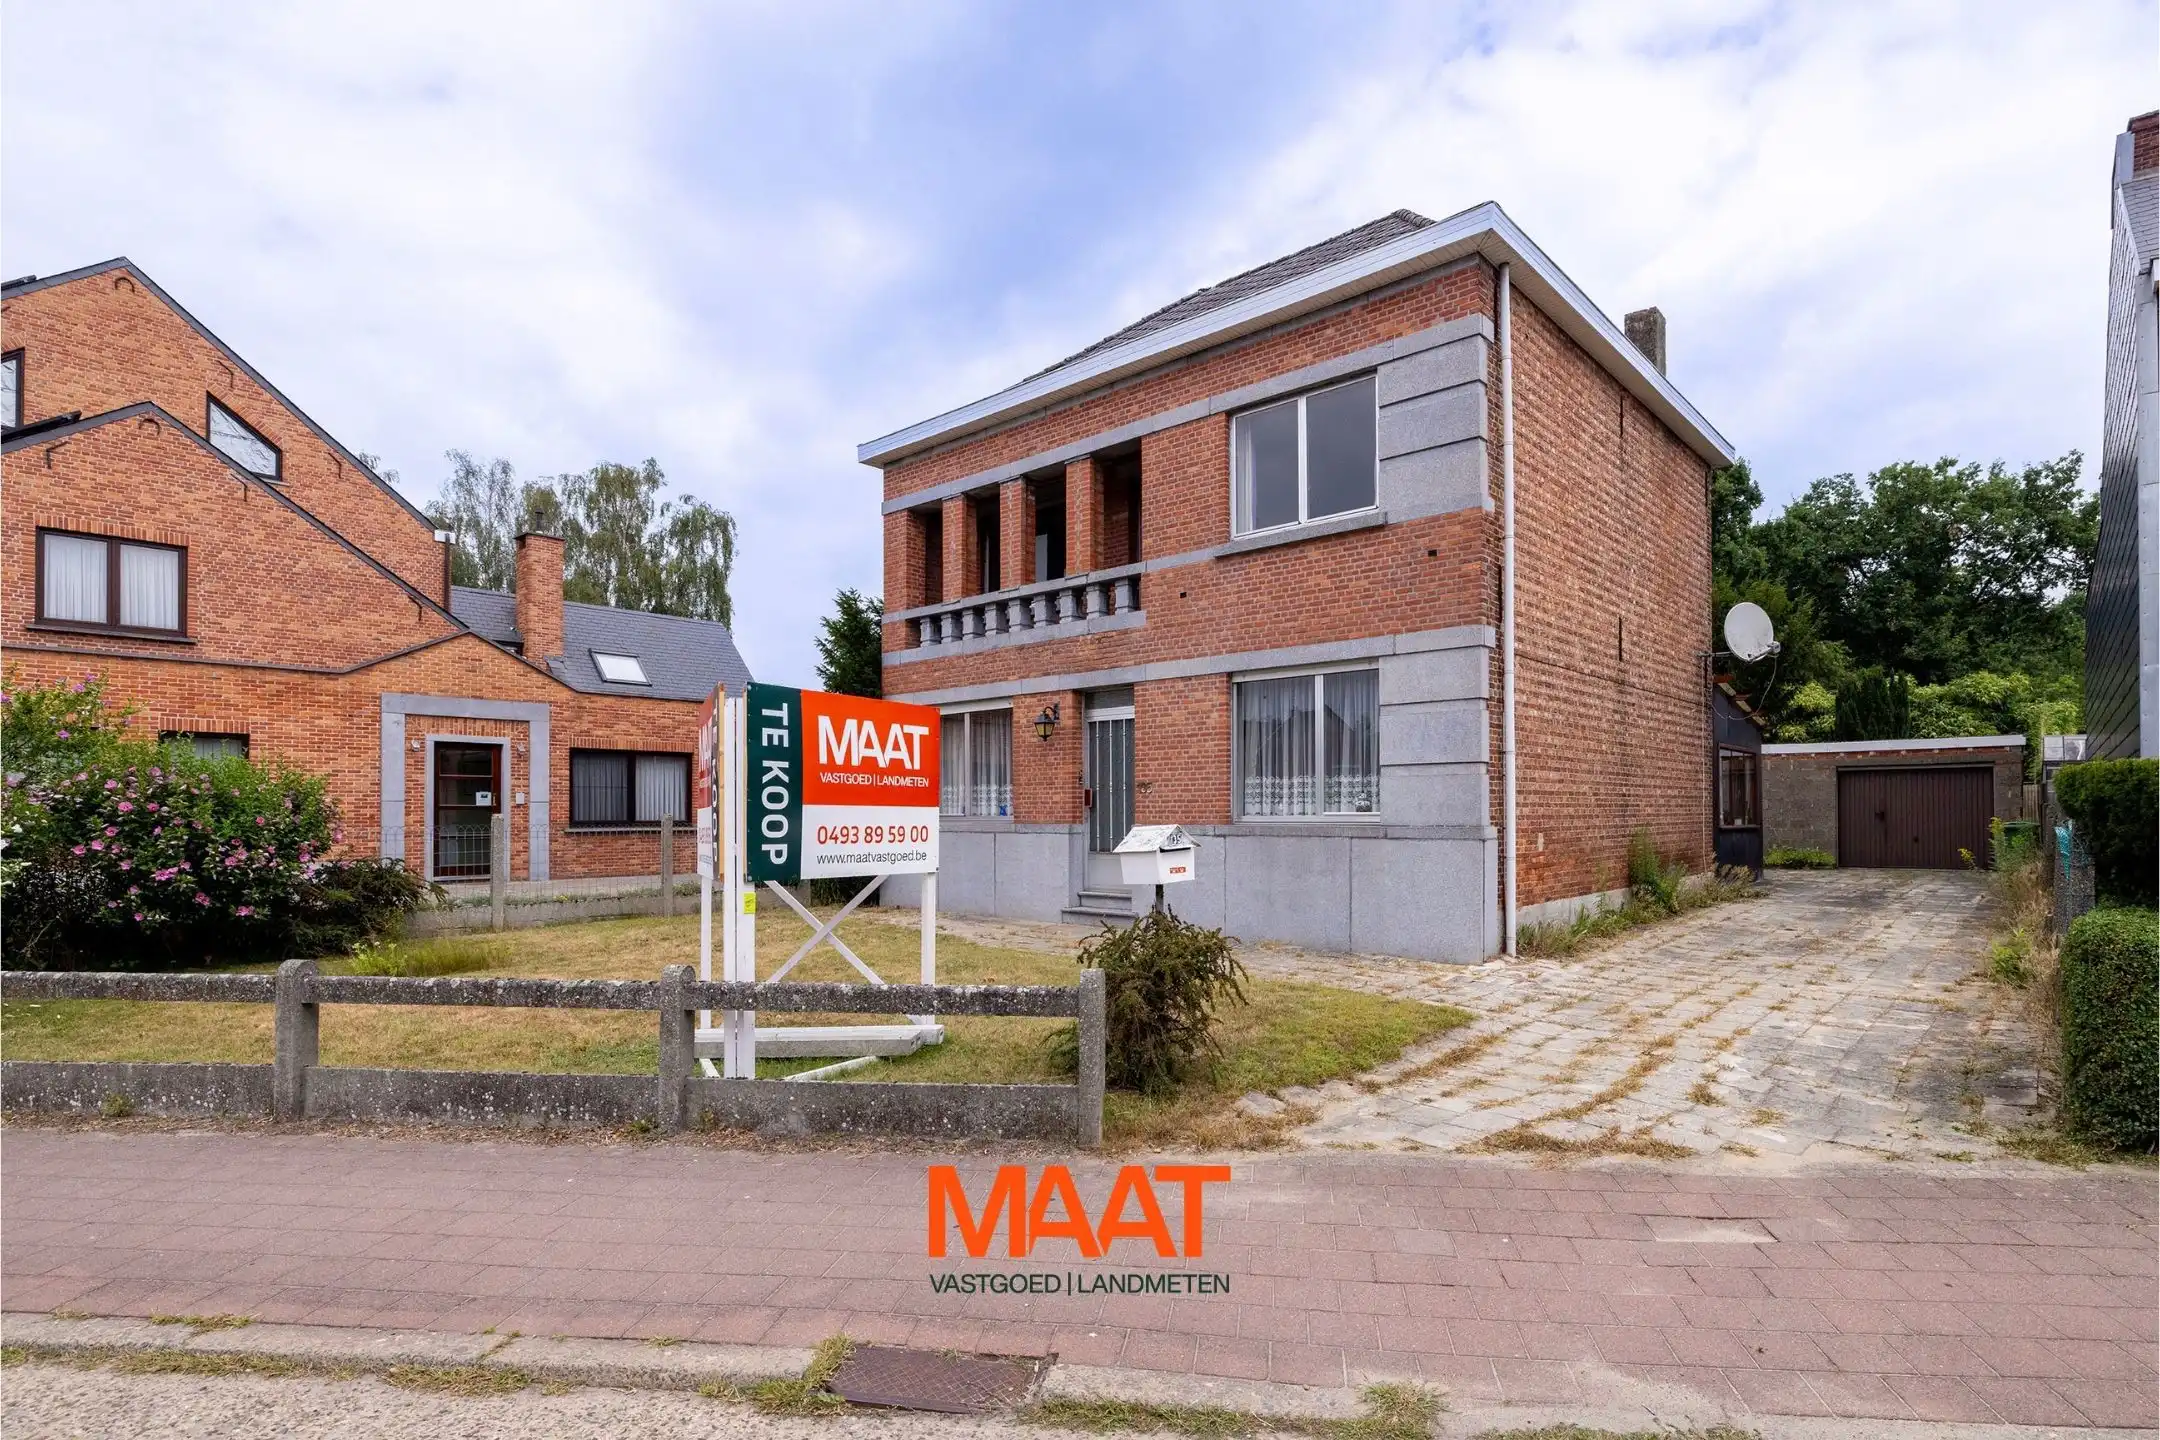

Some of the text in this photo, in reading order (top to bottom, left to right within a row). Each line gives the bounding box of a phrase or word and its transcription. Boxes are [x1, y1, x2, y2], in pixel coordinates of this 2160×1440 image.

[817, 715, 929, 770] MAAT
[761, 703, 790, 865] TE KOOP
[820, 772, 872, 785] VASTGOED
[877, 776, 929, 788] LANDMETEN
[817, 825, 929, 845] 0493 89 59 00
[816, 850, 927, 865] www.maatvastgoed.be
